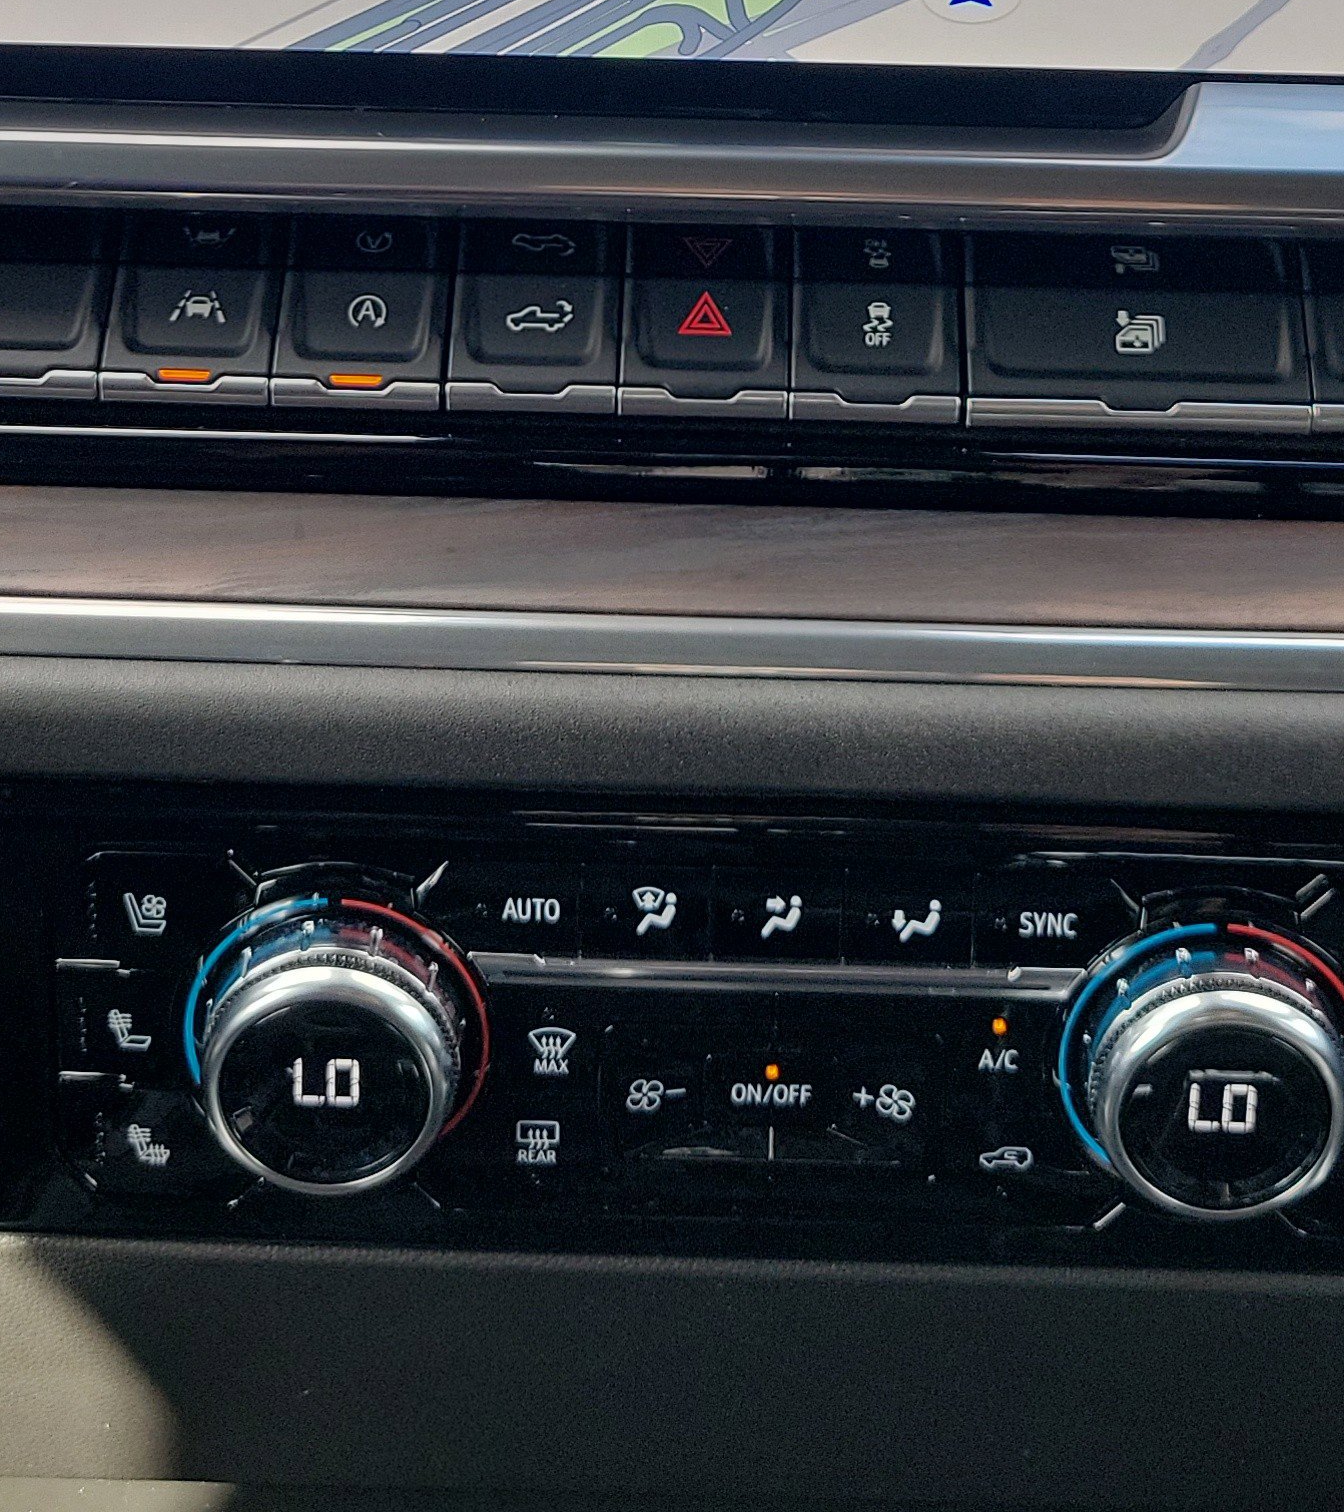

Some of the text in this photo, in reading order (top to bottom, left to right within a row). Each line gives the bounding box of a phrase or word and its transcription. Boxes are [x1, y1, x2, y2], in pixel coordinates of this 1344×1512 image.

[864, 332, 893, 347] OFF
[501, 896, 561, 924] AUTO
[1019, 911, 1079, 938] SYNC
[533, 1057, 570, 1075] MAX
[978, 1048, 1019, 1072] A/C
[291, 1056, 360, 1108] LO
[730, 1082, 813, 1107] ON/OFF
[1187, 1082, 1258, 1134] LO
[517, 1149, 557, 1165] REAR
